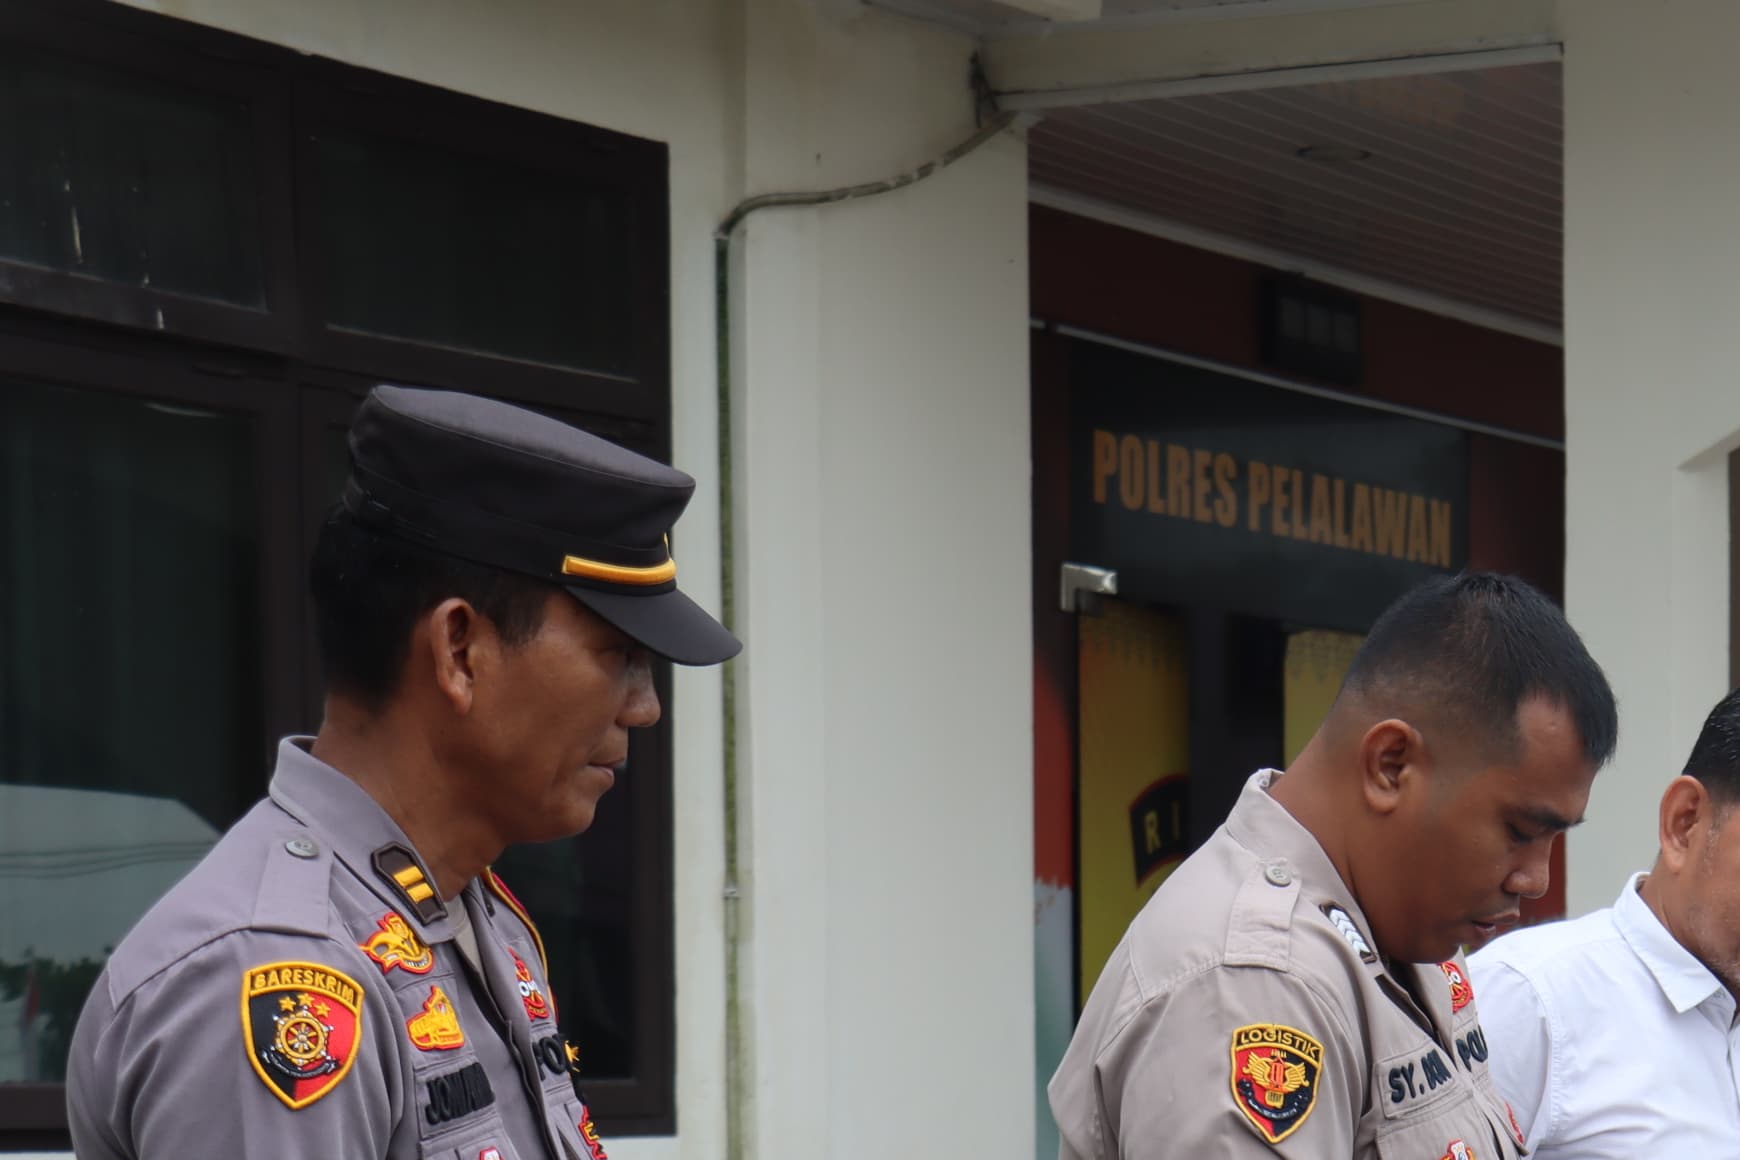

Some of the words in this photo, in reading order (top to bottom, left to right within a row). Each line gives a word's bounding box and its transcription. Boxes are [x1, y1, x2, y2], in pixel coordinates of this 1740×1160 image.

[1093, 429, 1237, 528] POLRES
[1248, 461, 1451, 569] PELALAWAN
[254, 968, 354, 1005] BARESKRIM
[1240, 1028, 1320, 1059] LOGISTIK
